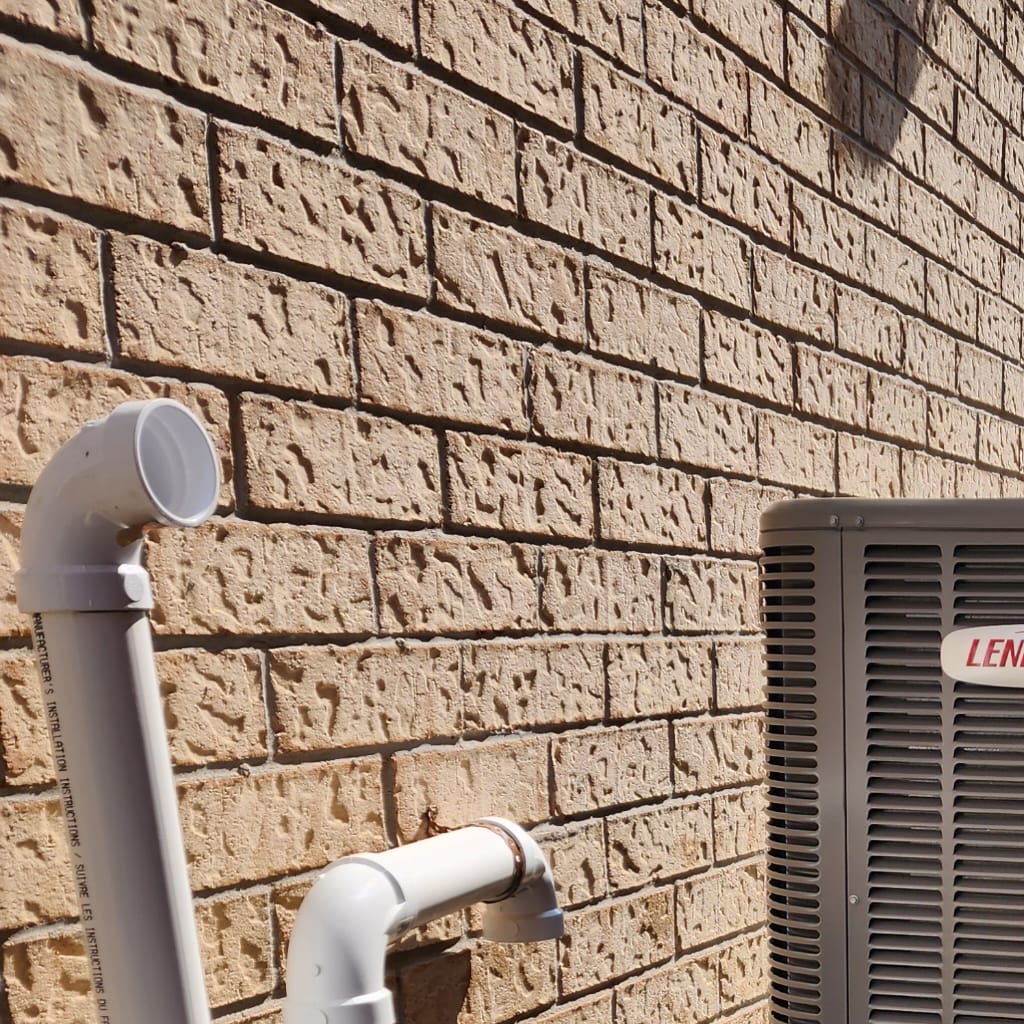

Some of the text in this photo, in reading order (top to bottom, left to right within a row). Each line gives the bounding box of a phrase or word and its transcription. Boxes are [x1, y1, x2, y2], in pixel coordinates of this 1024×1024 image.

[46, 701, 68, 772] INSTALLATION
[60, 778, 81, 847] INSTRUCTIONS
[75, 863, 90, 898] SUIVRE
[81, 903, 94, 922] LES
[85, 927, 105, 994] INSTRUCTIONS
[97, 998, 108, 1011] DU
